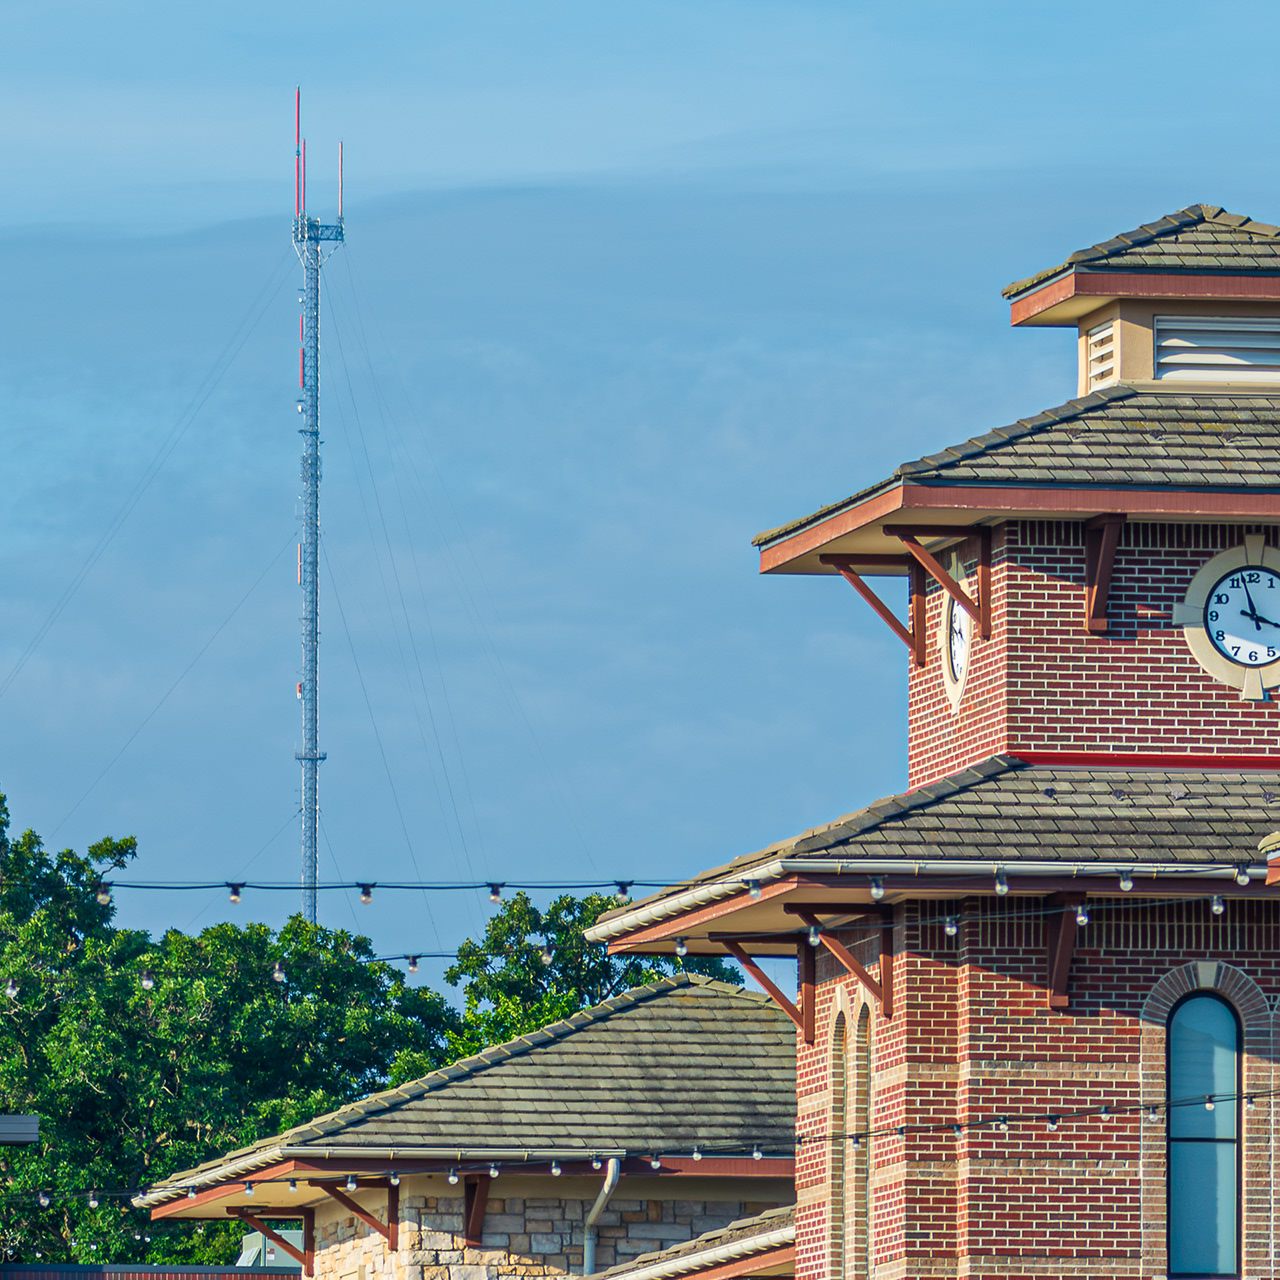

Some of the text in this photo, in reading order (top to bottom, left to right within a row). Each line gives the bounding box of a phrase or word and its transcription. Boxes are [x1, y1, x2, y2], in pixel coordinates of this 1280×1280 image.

[1229, 577, 1241, 588] 11
[1246, 572, 1260, 583] 12
[1267, 577, 1275, 588] 1
[1214, 593, 1229, 605] 10
[1209, 610, 1219, 622] 9
[1215, 630, 1225, 641] 8
[1231, 646, 1241, 656] 7
[1248, 651, 1258, 661] 6
[1266, 646, 1276, 657] 5
